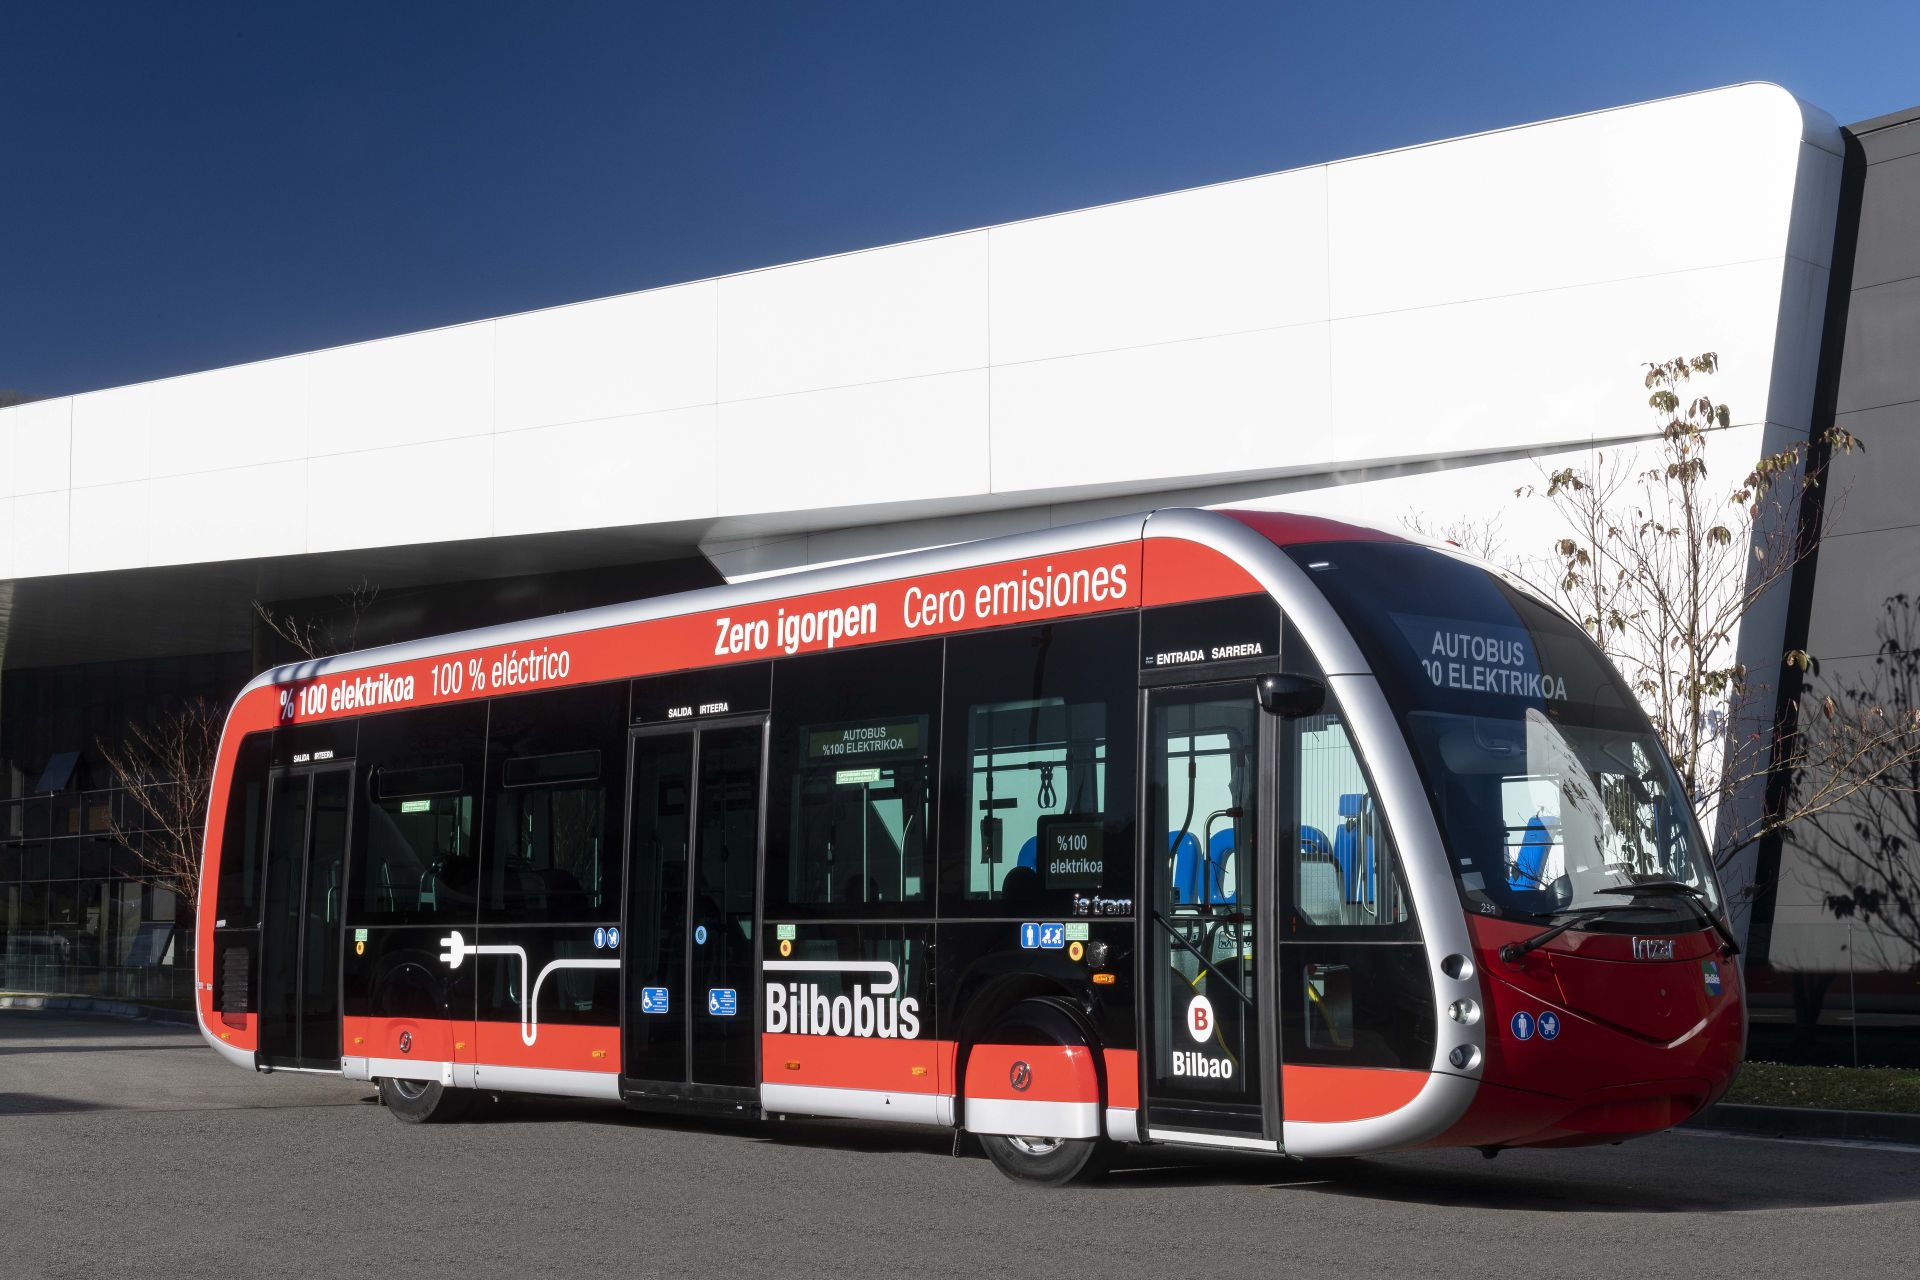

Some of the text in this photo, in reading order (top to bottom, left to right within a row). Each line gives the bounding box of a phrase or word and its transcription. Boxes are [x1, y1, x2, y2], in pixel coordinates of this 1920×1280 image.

[903, 563, 1127, 628] Cero emisiones
[714, 602, 877, 655] Zero igorpen
[1156, 649, 1205, 665] ENTRADA
[1211, 642, 1262, 659] SARRERA
[1432, 631, 1525, 666] AUTOBUS
[431, 647, 570, 696] 100 % eléctrico
[1449, 663, 1568, 700] ELEKTRIKOA
[280, 673, 415, 720] % 100 elektrikoa
[668, 702, 728, 718] SALIDA IRTEERA
[843, 727, 886, 741] AUTOBUS
[293, 753, 309, 762] SALIDA
[822, 738, 904, 756] %100 ELEKTRIKOA
[1057, 834, 1088, 851] %100
[1050, 858, 1103, 874] elektrikoa
[1092, 895, 1132, 915] tram
[766, 982, 920, 1040] Bilbobus
[1194, 1007, 1209, 1031] B
[1172, 1051, 1233, 1079] Bilbao
